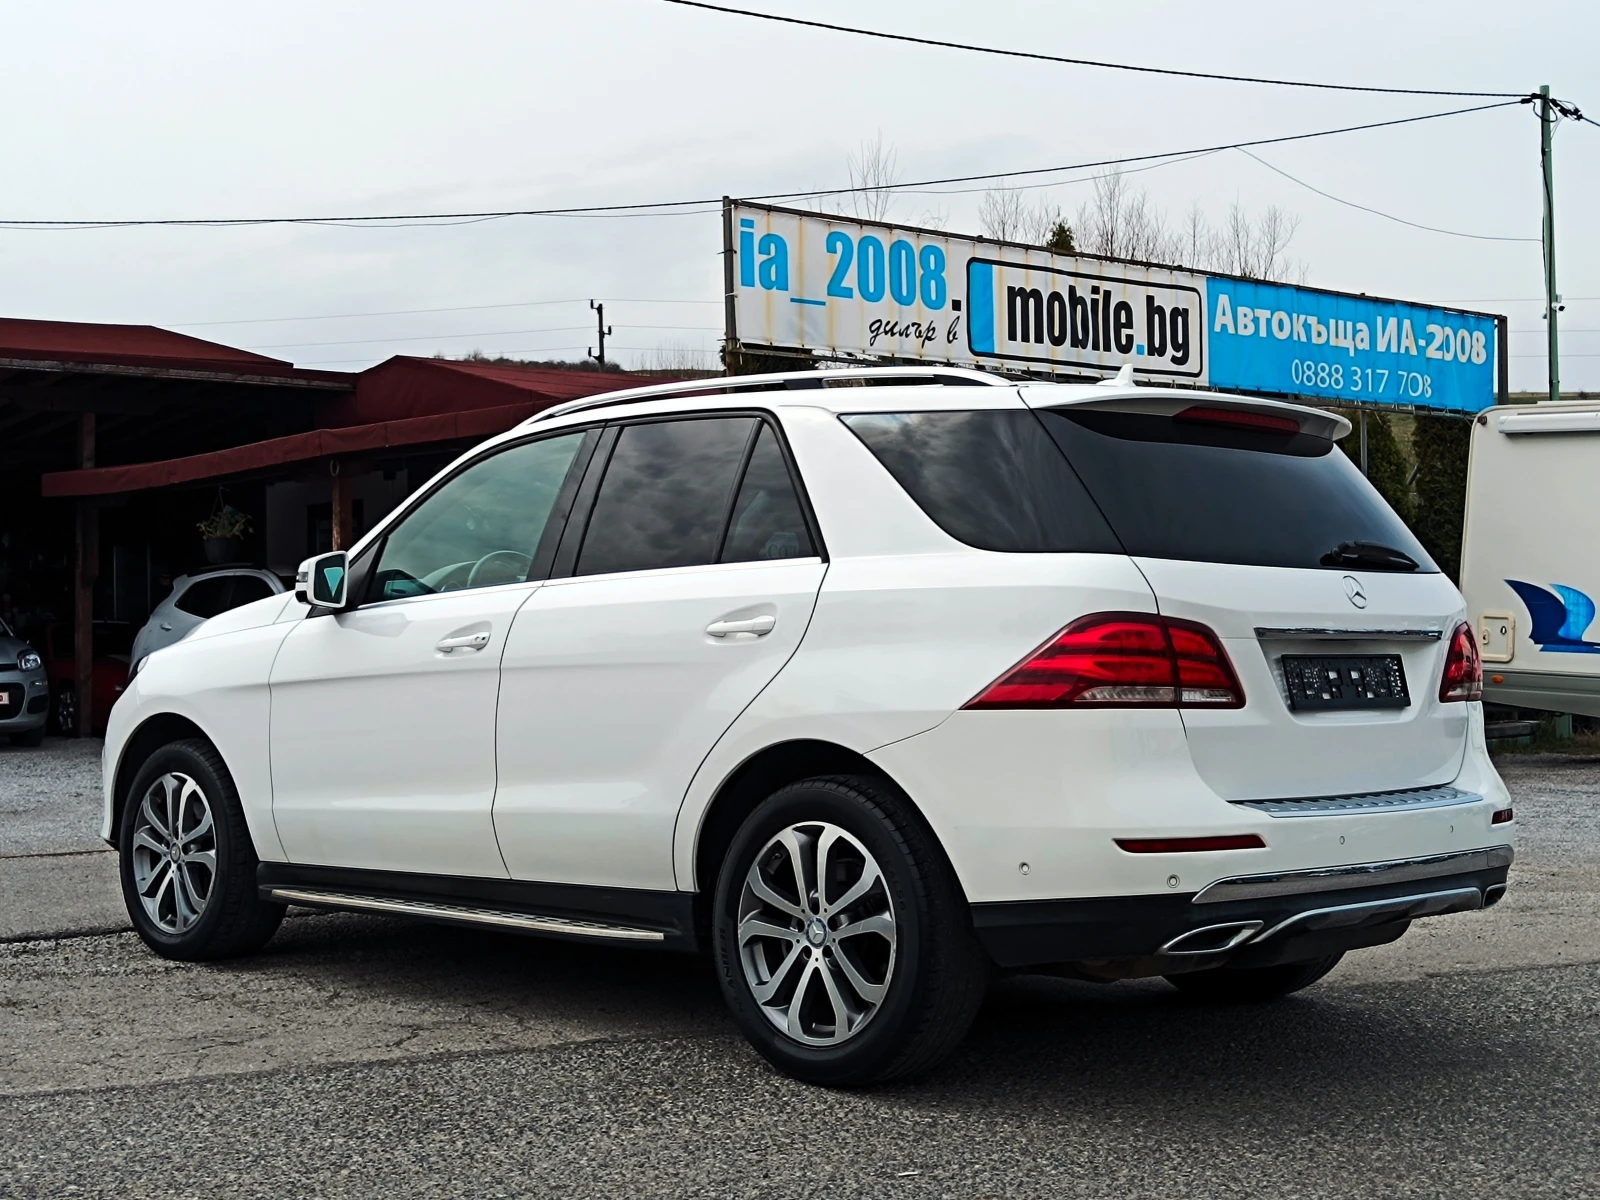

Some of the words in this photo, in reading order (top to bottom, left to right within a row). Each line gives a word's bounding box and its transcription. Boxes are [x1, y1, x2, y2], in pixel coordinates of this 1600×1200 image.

[868, 318, 938, 349] дилър
[946, 315, 961, 344] в
[1007, 285, 1190, 366] mobile.bg
[1213, 294, 1370, 356] Автокъща
[1377, 316, 1487, 365] ИА-2008
[1291, 359, 1344, 389] 0888
[1350, 366, 1389, 393] 317
[1398, 371, 1432, 398] 708
